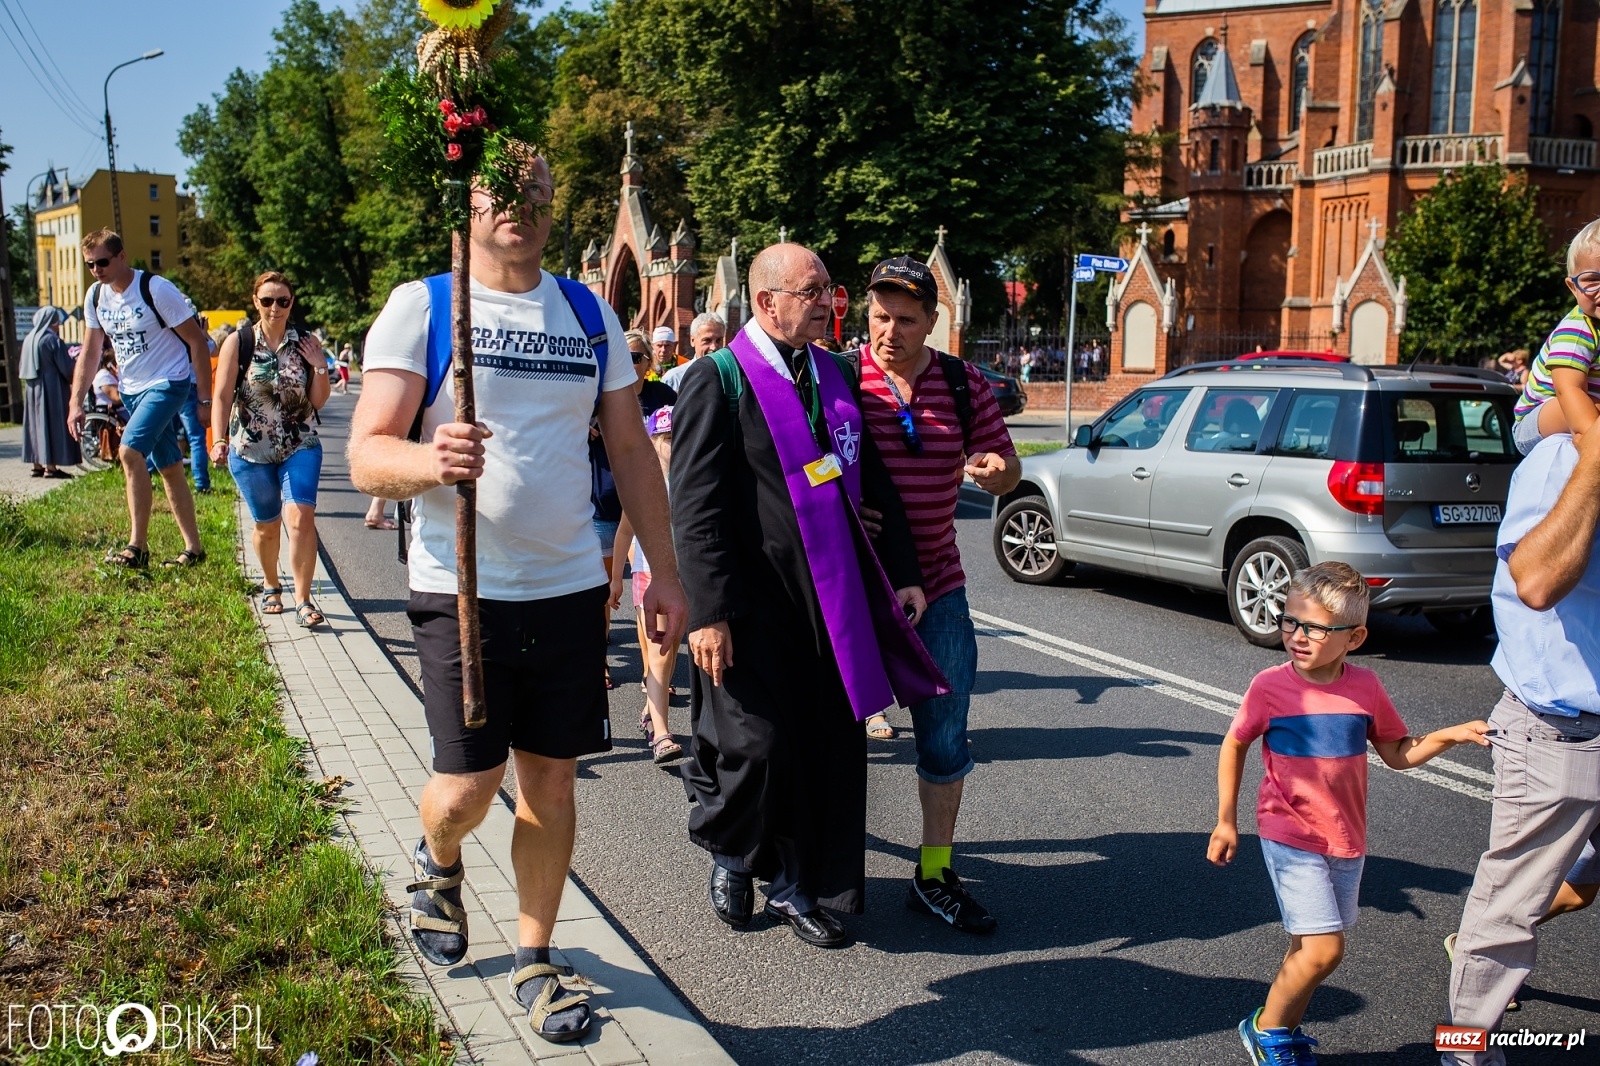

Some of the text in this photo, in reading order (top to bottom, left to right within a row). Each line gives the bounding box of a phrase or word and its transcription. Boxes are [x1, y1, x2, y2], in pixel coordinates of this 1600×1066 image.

[101, 307, 143, 321] THIS IS
[113, 322, 132, 331] THE
[112, 330, 147, 346] EST
[470, 326, 593, 360] CRAFTED GOODS
[114, 343, 149, 356] UMMER
[474, 356, 503, 367] ASUAL
[519, 361, 548, 371] URBAN
[552, 364, 570, 372] LIFE
[1441, 505, 1500, 522] SG 3270R
